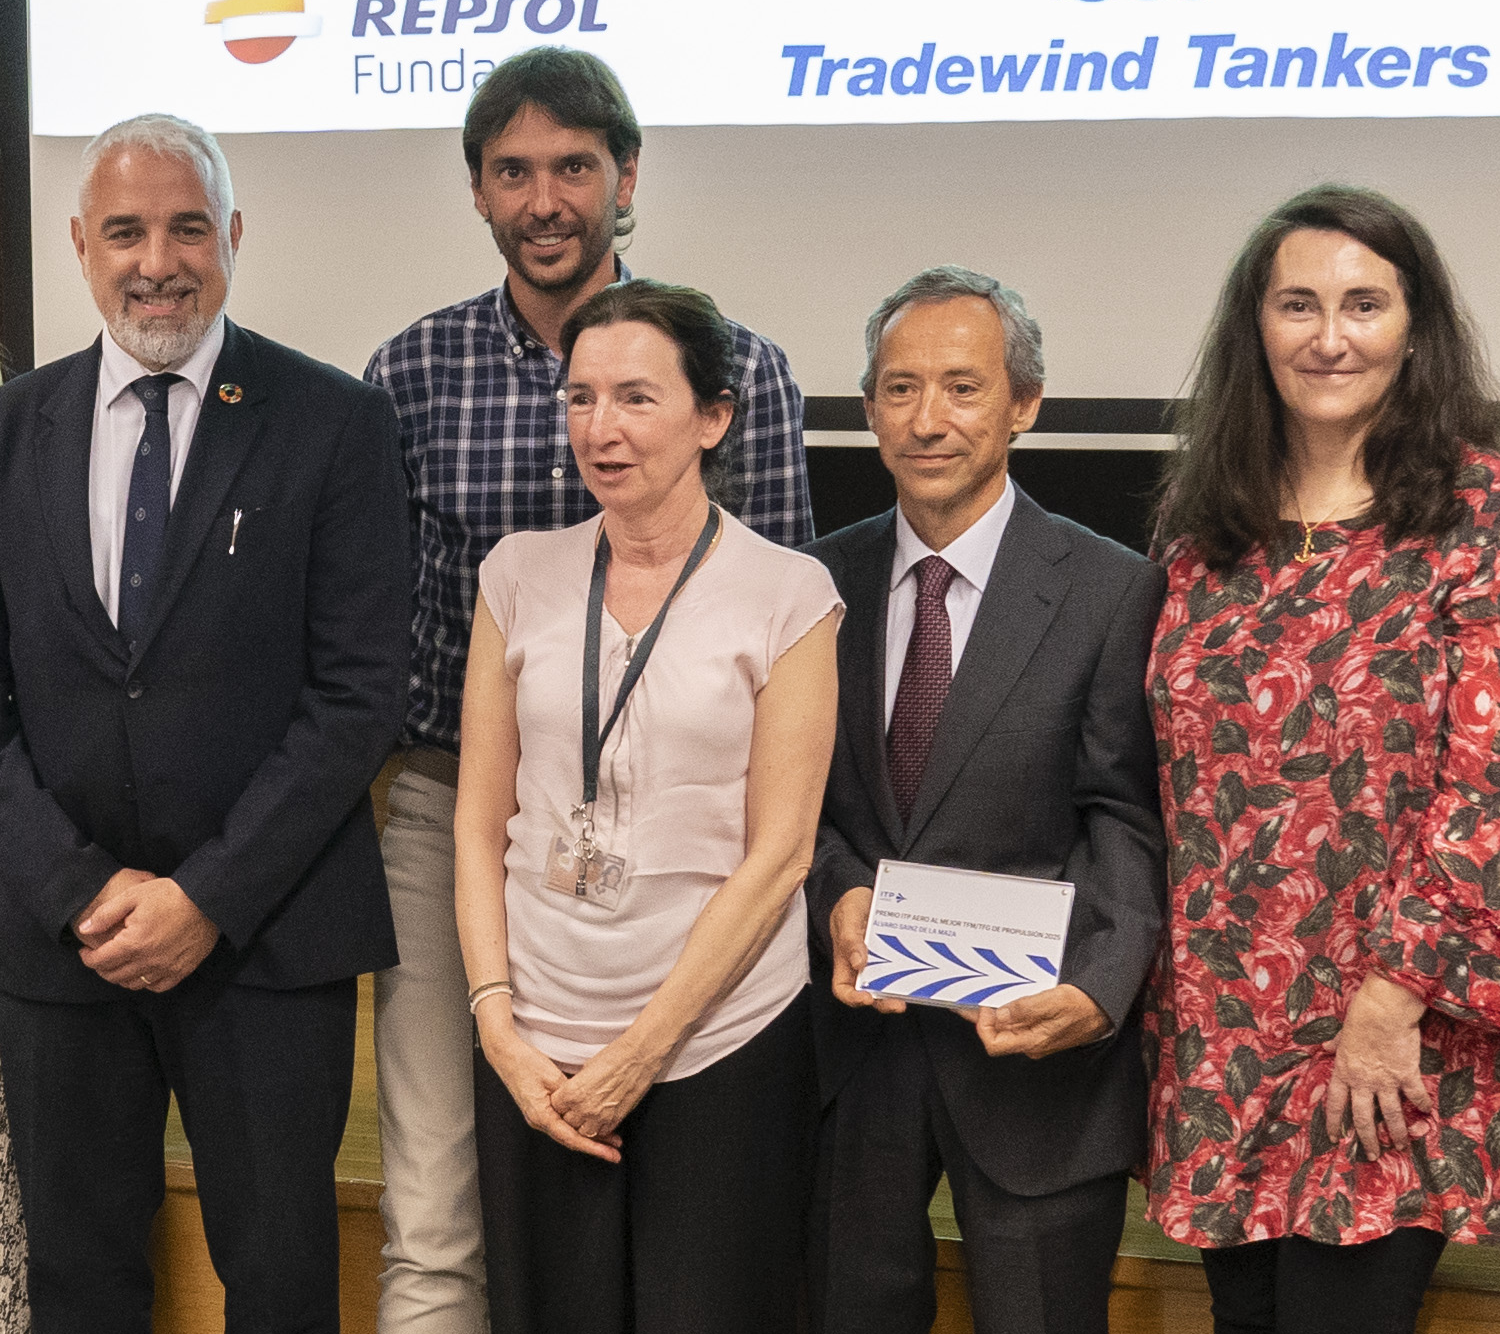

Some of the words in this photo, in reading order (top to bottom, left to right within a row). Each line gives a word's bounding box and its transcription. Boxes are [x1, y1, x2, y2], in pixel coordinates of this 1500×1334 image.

[352, 46, 501, 95] Funda
[779, 35, 1160, 98] Tradewind
[1186, 31, 1493, 91] Tankers
[880, 891, 894, 899] ITP
[875, 909, 900, 918] PREMIO
[940, 918, 961, 926] MEJOR
[963, 920, 990, 931] TFM/TFG
[1044, 932, 1061, 940] 2025
